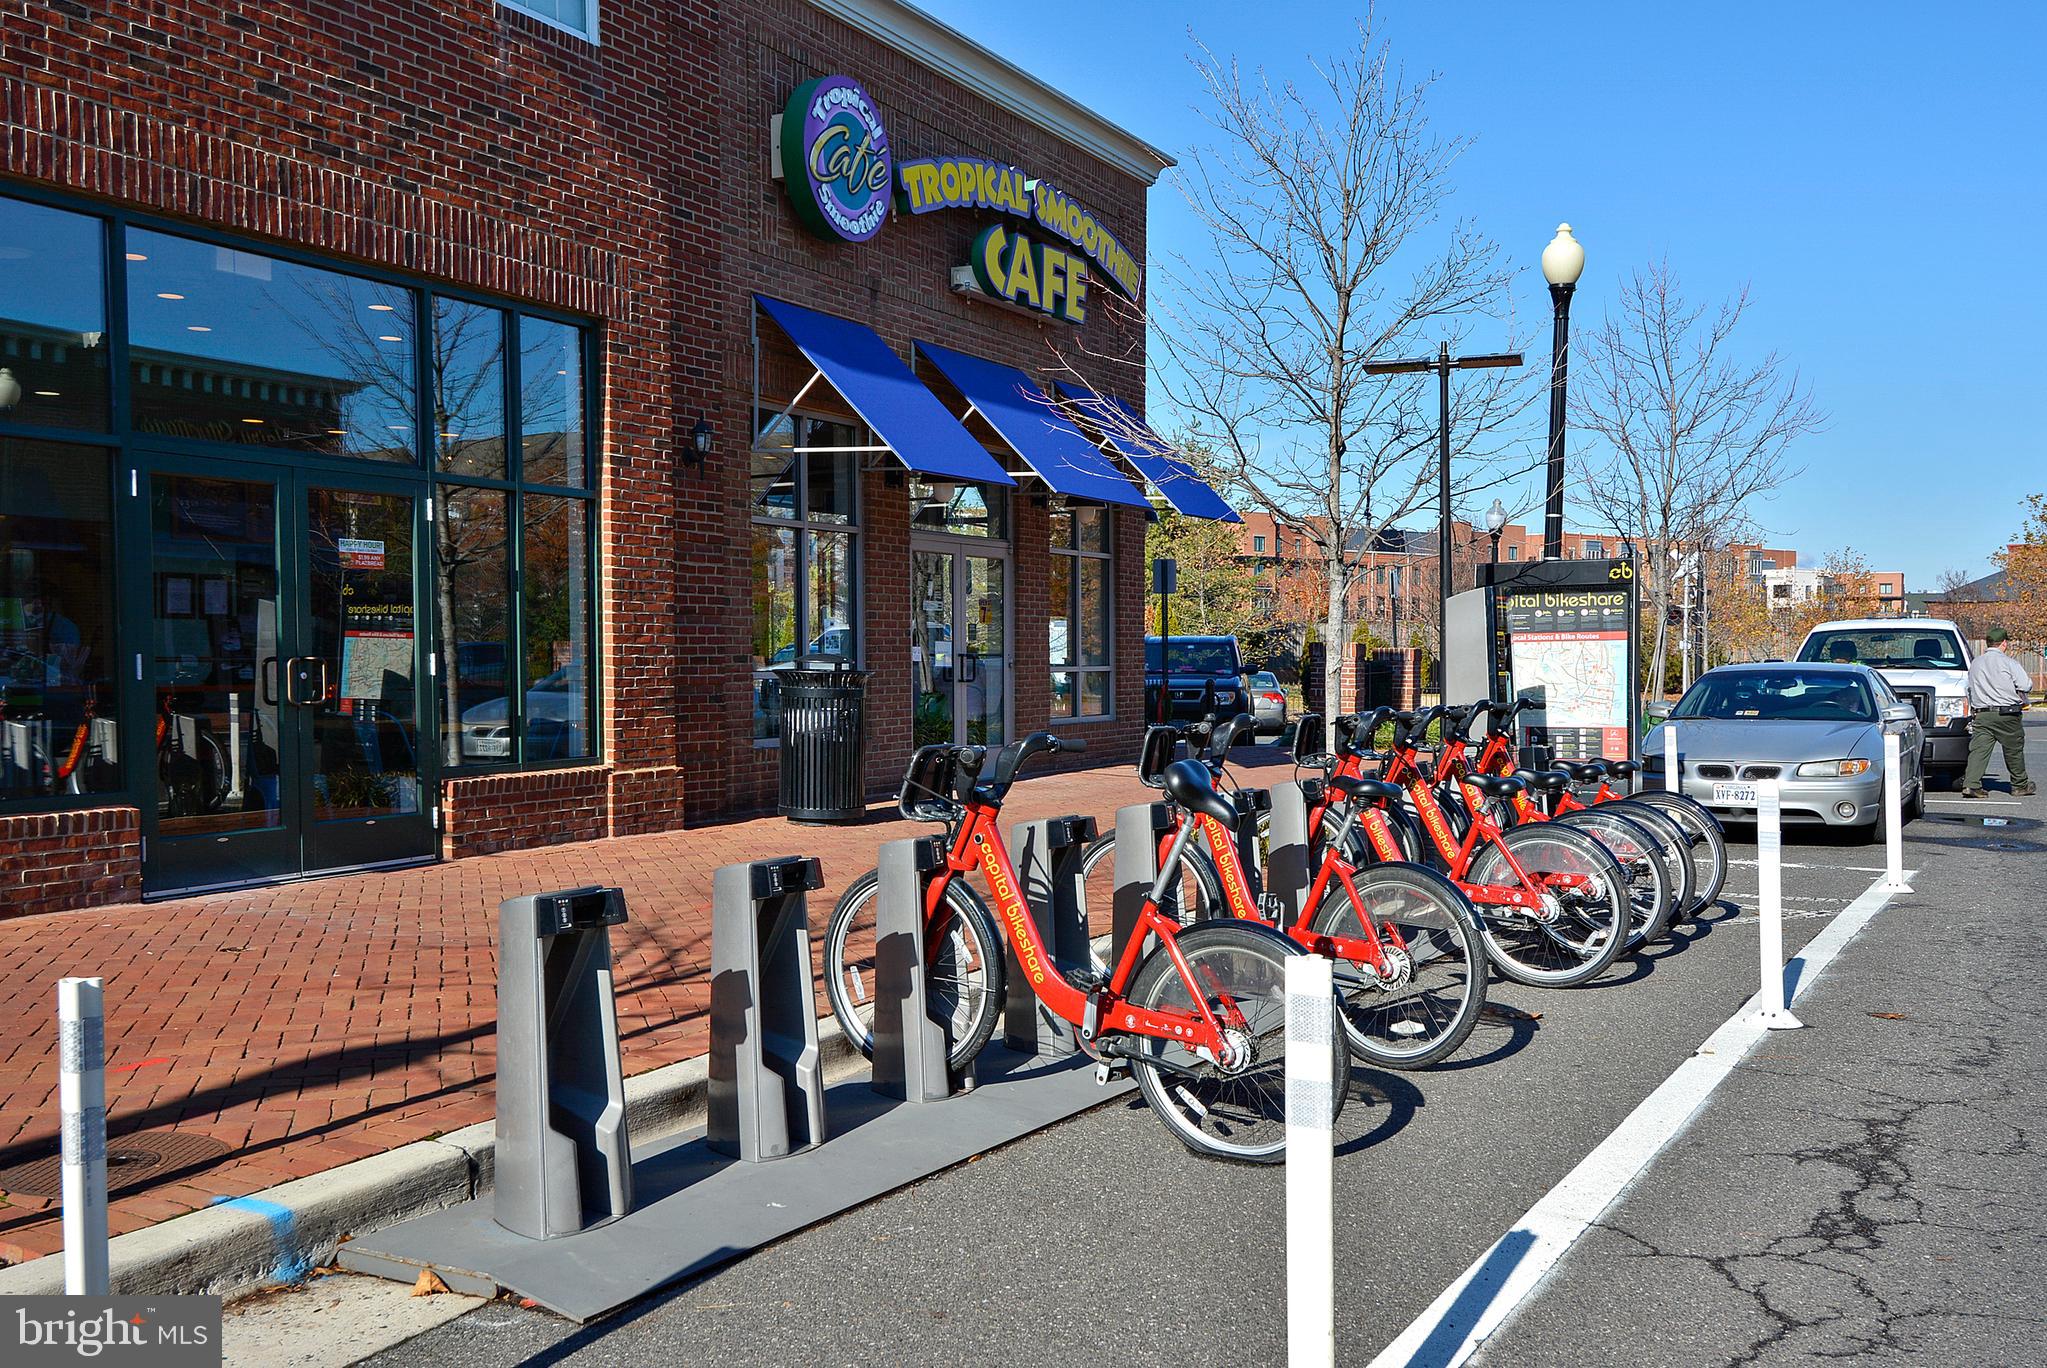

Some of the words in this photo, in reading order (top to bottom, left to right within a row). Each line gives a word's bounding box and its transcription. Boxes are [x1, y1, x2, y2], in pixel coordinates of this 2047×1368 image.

[811, 86, 883, 141] Tropical
[809, 125, 889, 194] Café
[819, 184, 885, 235] Smoothie
[901, 163, 1031, 215] TROPICAL
[1035, 181, 1141, 295] SMOOTHIE
[986, 224, 1087, 323] CAFE
[1545, 591, 1624, 608] bikeshare
[1715, 789, 1756, 801] XVF-8272
[1426, 807, 1456, 859] bikeshare
[980, 842, 1015, 902] capital
[1006, 899, 1044, 984] bikeshare
[1219, 851, 1247, 919] bikeshare
